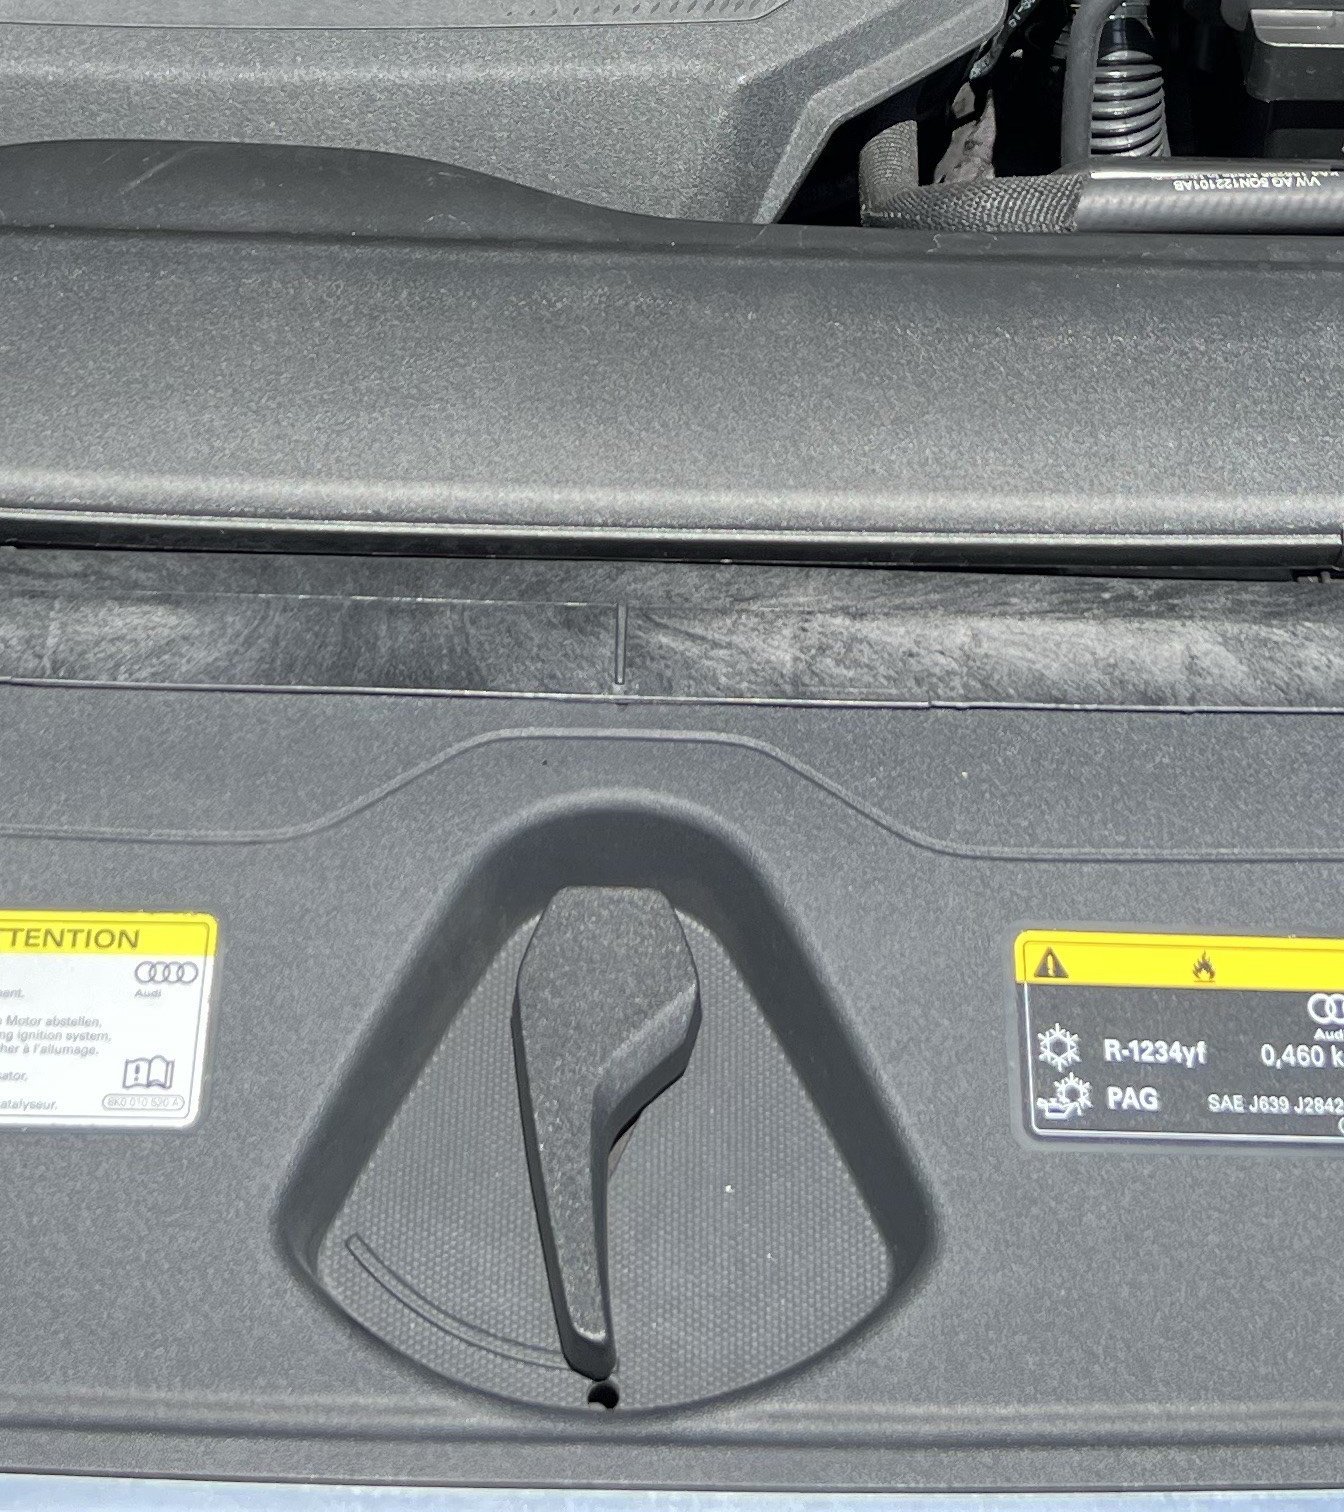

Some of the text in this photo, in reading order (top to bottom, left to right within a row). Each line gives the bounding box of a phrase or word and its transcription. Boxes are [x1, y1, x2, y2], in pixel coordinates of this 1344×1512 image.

[1272, 176, 1293, 188] AG
[1296, 176, 1321, 187] VW
[134, 989, 162, 999] Audi
[6, 1015, 41, 1026] Motor
[17, 1030, 61, 1042] ignition
[1103, 1038, 1207, 1069] R-1234yf
[1260, 1044, 1325, 1069] 0,460
[1106, 1087, 1160, 1112] PAG
[1207, 1094, 1244, 1113] SAE
[1249, 1095, 1290, 1114] J639
[1294, 1095, 1344, 1115] J2842
